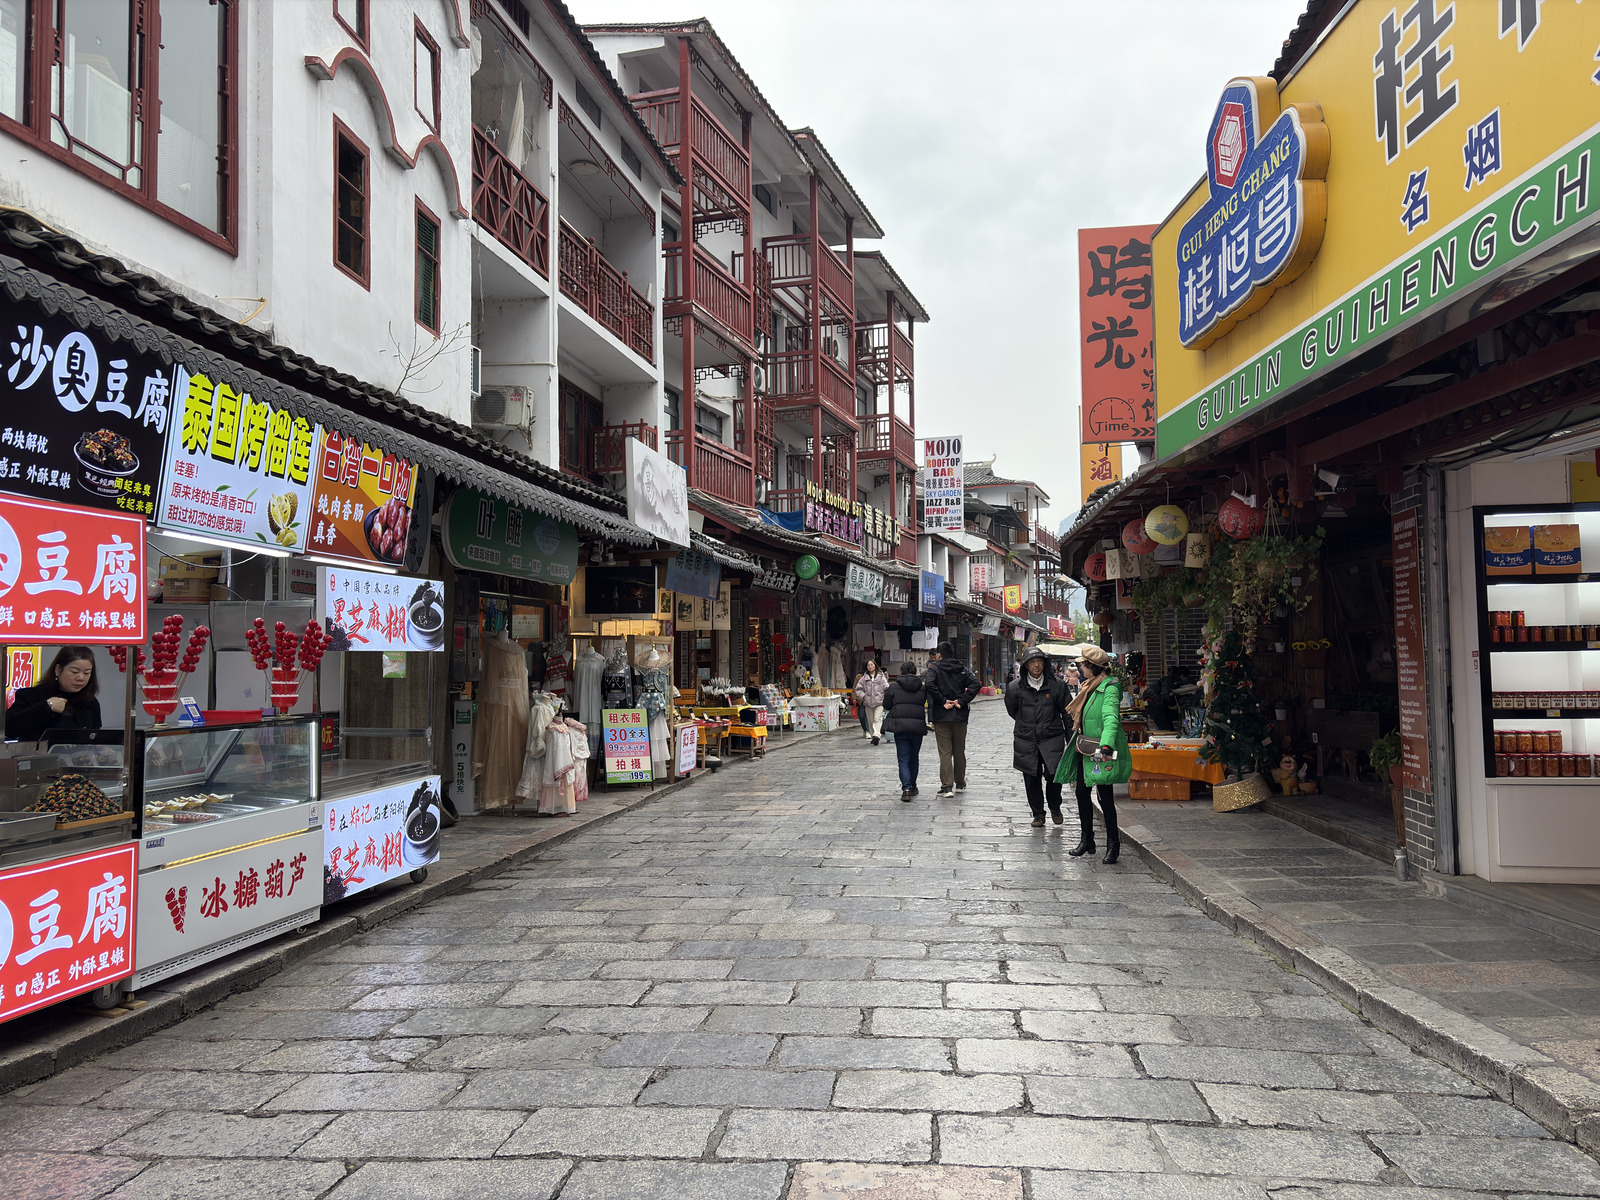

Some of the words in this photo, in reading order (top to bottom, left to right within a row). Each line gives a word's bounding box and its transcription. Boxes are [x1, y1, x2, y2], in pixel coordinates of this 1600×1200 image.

[1400, 107, 1503, 235] 名烟
[1181, 234, 1204, 264] GUI
[1205, 196, 1239, 242] HENG
[1240, 134, 1292, 204] CHANG
[1086, 237, 1152, 370] 時光
[1197, 350, 1282, 431] GUILIN
[1300, 149, 1592, 372] GUIHENGCH
[7, 325, 169, 434] 沙臭豆腐
[181, 373, 315, 486] 泰国烤榴莲
[1095, 418, 1130, 434] Time
[1, 427, 49, 455] 两块解忧
[925, 438, 962, 458] MOJO
[322, 428, 413, 501] 台湾一口肠
[926, 457, 961, 468] ROOFTOP
[932, 467, 954, 477] BAR
[1089, 456, 1113, 482] 酒
[26, 463, 71, 490] 外酥里嫩
[114, 476, 151, 497] 闻起来臭
[925, 477, 961, 490] 观景星空露台
[116, 496, 154, 515] 吃起来香
[806, 479, 823, 504] Mojo
[825, 488, 850, 516] Rooftop
[852, 500, 863, 518] Bar
[925, 490, 937, 498] SKY
[938, 489, 962, 498] GARDEN
[925, 498, 942, 507] JAZZ
[944, 497, 961, 507] R&B
[317, 493, 364, 523] 纯肉香肠
[925, 507, 949, 516] HIPHOP
[313, 523, 337, 546] 真香
[476, 498, 524, 548] 叶雕
[0, 530, 137, 604] 豆腐
[343, 578, 400, 597] 中国营养品牌
[24, 607, 71, 629] 口感正
[79, 609, 137, 630] 外酥里嫩
[331, 597, 407, 645] 黑芝麻糊
[6, 651, 33, 689] 肠
[608, 712, 641, 724] 租衣服
[609, 728, 628, 742] 30
[629, 729, 646, 739] 全天
[615, 758, 641, 771] 拍摄
[326, 828, 403, 888] 黑芝麻糊
[198, 851, 308, 919] 冰糖葫芦
[15, 872, 127, 967] 豆腐
[14, 968, 61, 998] 口感正
[67, 945, 126, 982] 外酥里嫩
